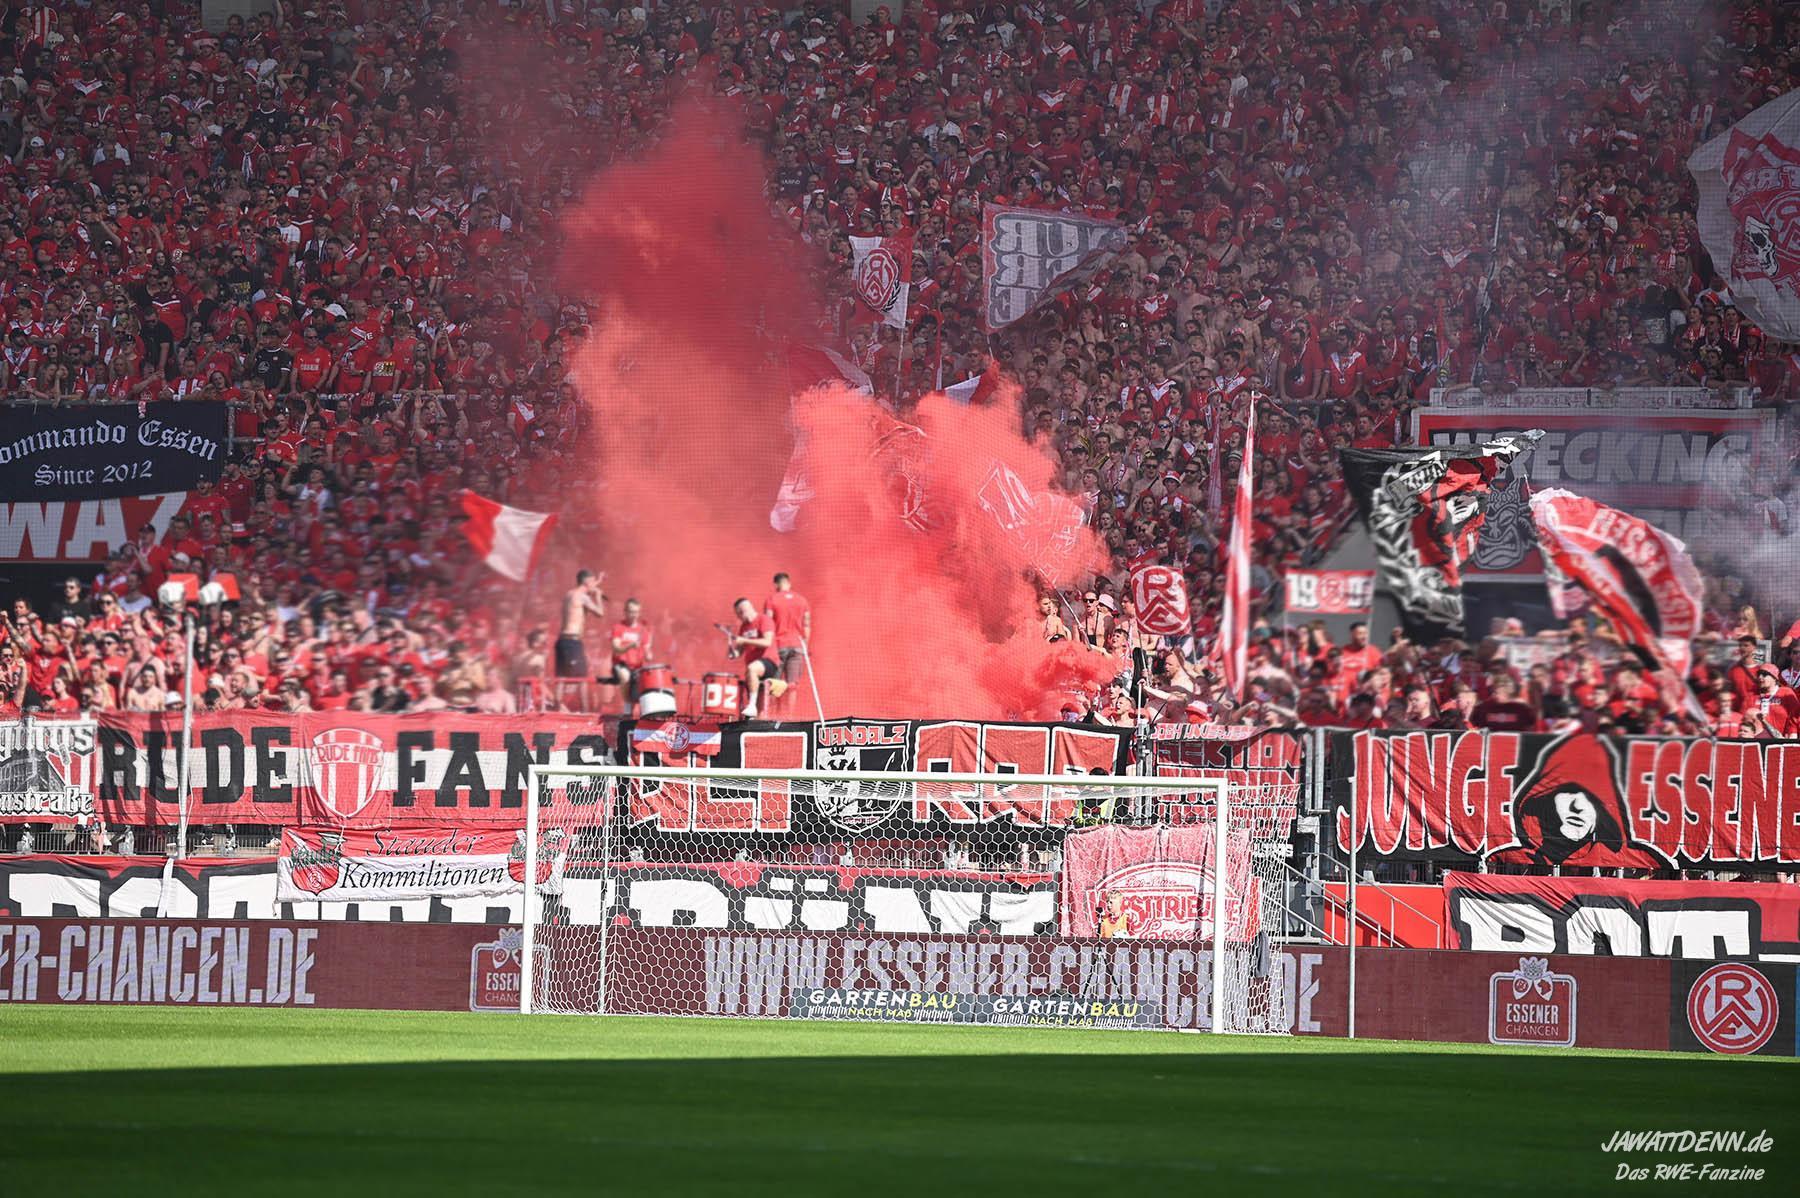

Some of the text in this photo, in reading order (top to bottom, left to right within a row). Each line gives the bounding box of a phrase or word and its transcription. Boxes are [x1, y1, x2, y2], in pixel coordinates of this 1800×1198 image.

[138, 420, 218, 461] Essen
[1433, 432, 1750, 482] RECKING
[35, 460, 153, 486] Since 2012
[819, 725, 906, 746] VANDALZ
[317, 744, 350, 763] RUDE
[99, 726, 610, 808] RUDE FANS
[1337, 731, 1521, 856] JUNGE
[367, 829, 485, 857] Stauder
[339, 860, 504, 889] Kommilitonen
[486, 972, 521, 991] ESSEN
[485, 993, 521, 1003] CHANC
[809, 990, 958, 1010] GARTENBAU
[993, 998, 1138, 1018] GARTENBAU
[848, 1007, 881, 1017] NACH
[1030, 1016, 1064, 1025] NACH
[1506, 1003, 1559, 1025] ESSENER
[1505, 1025, 1560, 1037] CHANCEN
